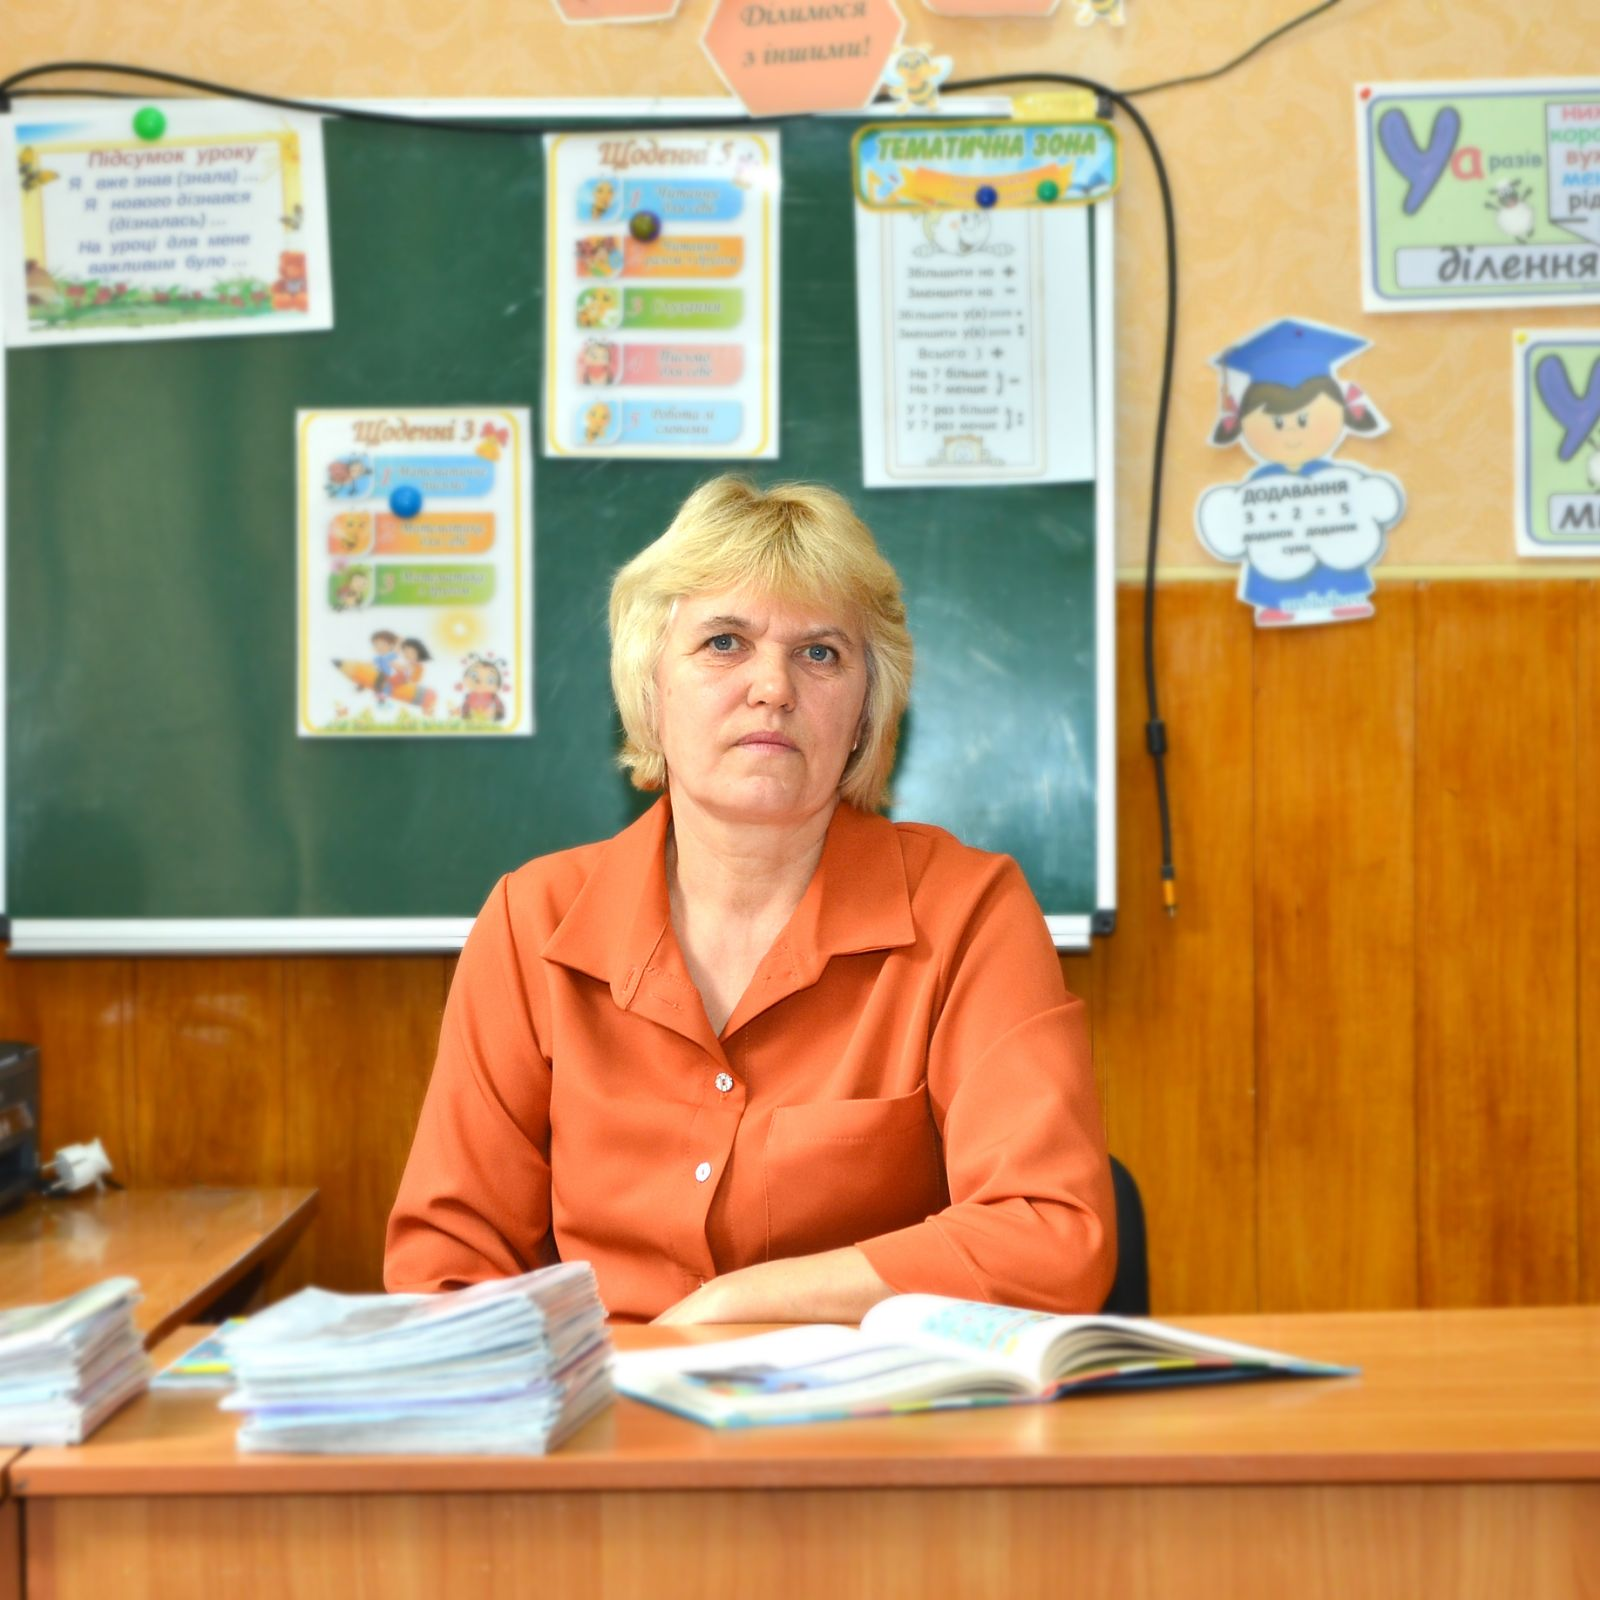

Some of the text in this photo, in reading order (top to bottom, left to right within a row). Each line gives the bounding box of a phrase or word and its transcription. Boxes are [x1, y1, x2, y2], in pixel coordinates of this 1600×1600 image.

[741, 1, 866, 26] Ділимося
[742, 35, 870, 68] з іншими!
[88, 146, 257, 169] Підсумок уроку
[598, 139, 709, 171] Щоденні
[878, 132, 1096, 161] ТЕМАТИЧНА ЗОНА
[1489, 153, 1543, 175] разів
[69, 177, 81, 190] Я
[96, 177, 128, 189] вже
[133, 175, 172, 188] знав
[176, 169, 238, 188] (знала)
[1562, 171, 1600, 187] ме
[84, 190, 251, 211] Я нового дізнався
[109, 213, 206, 233] (дізналась)
[79, 233, 250, 256] На уроці для мене
[88, 260, 176, 275] важливим
[185, 254, 226, 271] було
[1438, 244, 1599, 283] ділення
[918, 346, 967, 360] Всього
[352, 417, 475, 446] Щоденні 3
[1242, 481, 1348, 506] ДОДАВАННЯ
[1292, 507, 1301, 520] 2
[1340, 503, 1350, 515] 5
[1242, 522, 1358, 543] доданок доданок
[1282, 544, 1311, 556] сума
